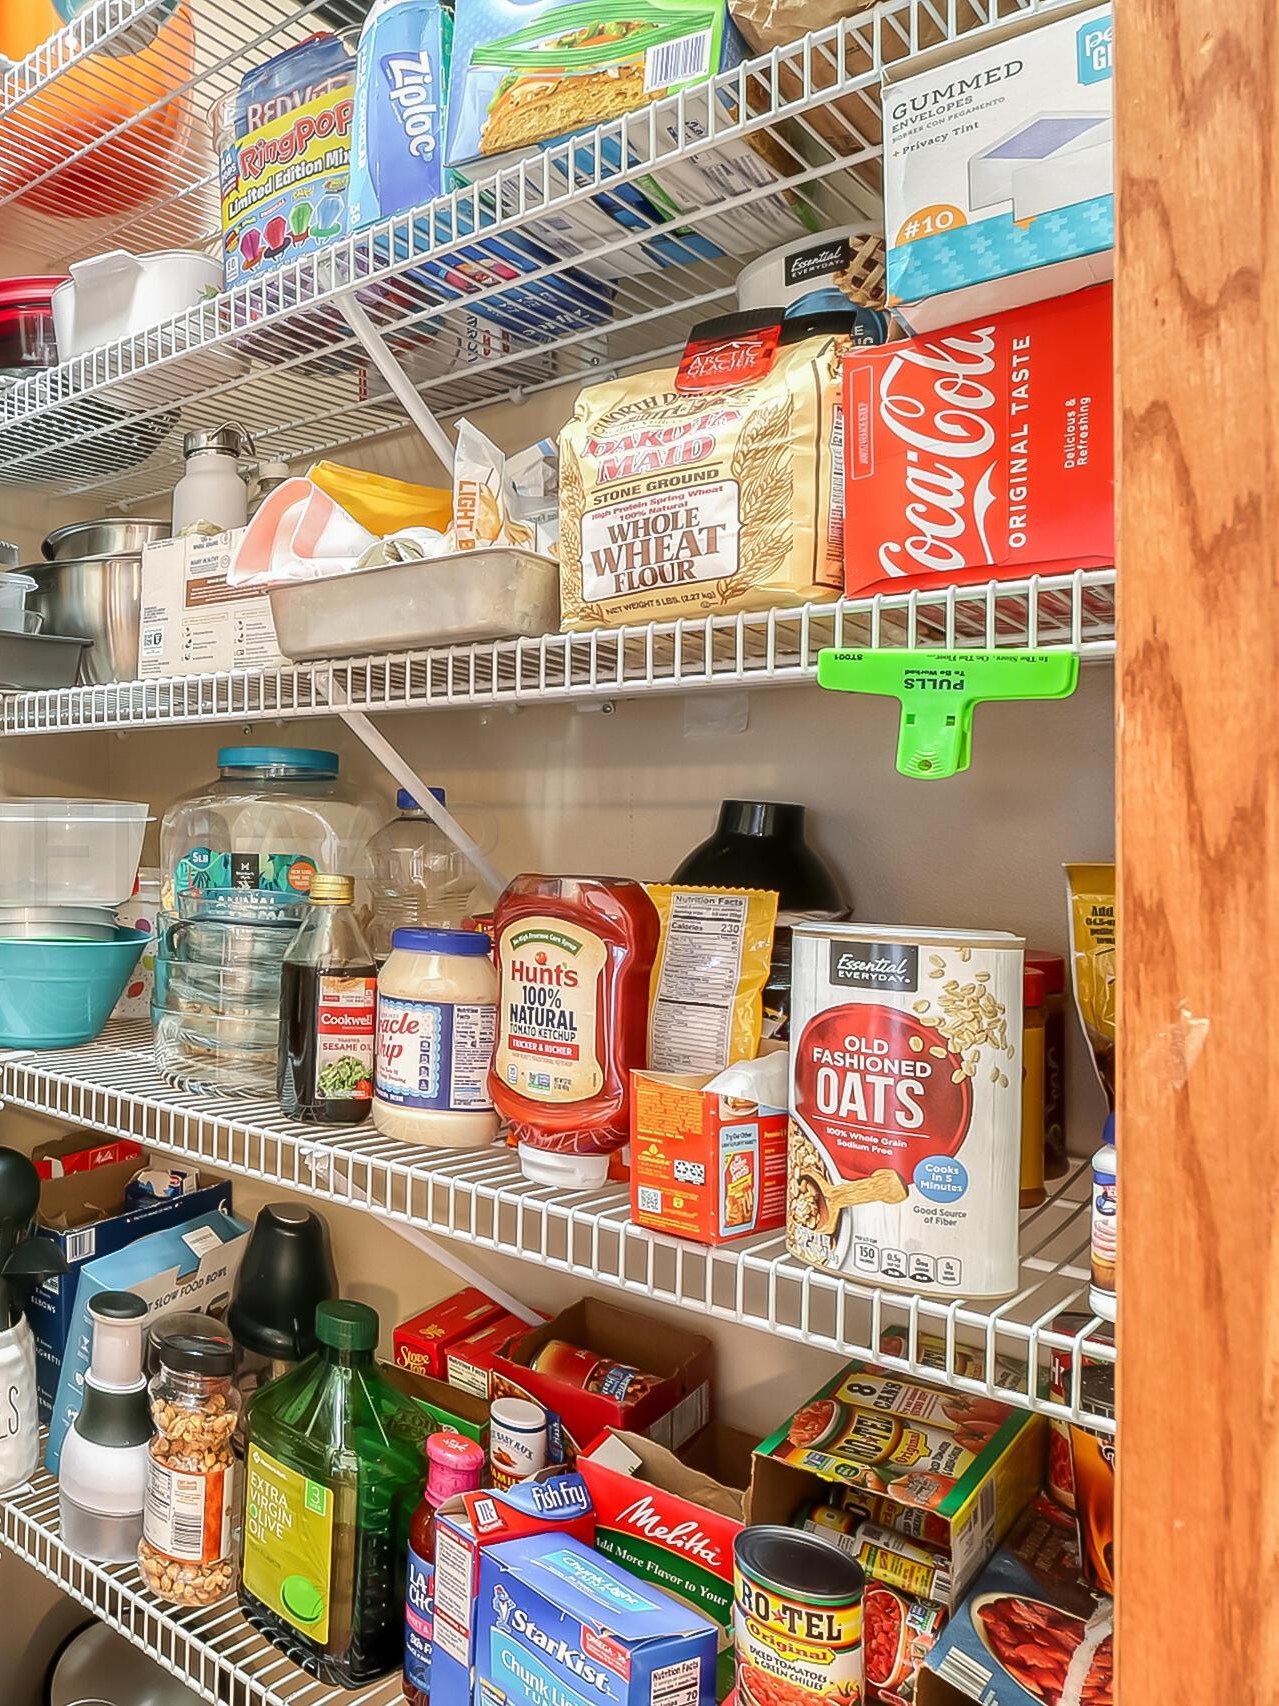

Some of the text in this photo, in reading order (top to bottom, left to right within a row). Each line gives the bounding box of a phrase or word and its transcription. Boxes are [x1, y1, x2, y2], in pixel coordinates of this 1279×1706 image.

[389, 51, 438, 159] Ziploc
[892, 60, 1023, 121] GUMMED
[892, 95, 974, 134] ENVELOPES
[921, 96, 1006, 132] CON PEGAMENTO
[903, 121, 979, 156] Privacy Tint
[228, 147, 350, 221] Limited Edition Mix
[904, 210, 955, 239] #10
[790, 246, 842, 272] Essential
[791, 260, 842, 279] EVERYDAY
[687, 356, 755, 377] GLACIER
[690, 345, 761, 370] ARCTIC
[605, 395, 658, 423] NORTH
[581, 410, 743, 458] DAKOTA
[1009, 335, 1031, 548] ORIGINAL TASTE
[1064, 409, 1076, 469] Delicious
[1077, 397, 1091, 466] Refreshing
[596, 434, 716, 485] MAID
[593, 469, 719, 506] STONE GROUND
[613, 501, 647, 515] Protein
[650, 494, 685, 506] Spring
[688, 485, 724, 498] Wheat
[457, 480, 478, 531] LIGHT
[649, 501, 688, 514] Natural
[607, 507, 700, 544] WHOLE
[591, 523, 726, 577] WHEAT
[613, 559, 697, 594] FLOUR
[624, 600, 654, 612] WEIGHT
[904, 678, 965, 690] PULLS
[675, 895, 743, 907] Nutrition Facts
[671, 922, 740, 934] Calories 230
[511, 960, 579, 988] Hunt's
[837, 953, 908, 975] Essential
[838, 970, 904, 984] EVERYDAY
[522, 985, 562, 1009] 100%
[510, 1003, 578, 1032] NATURAL
[510, 1022, 576, 1042] TOMATO KETCHUP
[323, 1042, 357, 1052] SESAME
[844, 1035, 889, 1056] OLD
[812, 1047, 933, 1079] FASHIONED
[816, 1066, 925, 1129] OATS
[826, 1126, 908, 1148] 100% Whole Grain
[837, 1138, 893, 1155] Sodium Free
[925, 1163, 959, 1175] Cooks
[921, 1181, 963, 1192] Minutes
[913, 1205, 967, 1218] Good Source
[924, 1215, 957, 1226] of Fiber
[859, 1246, 875, 1259] 150
[154, 1286, 178, 1311] SLOW
[180, 1278, 205, 1300] FOOD
[397, 1345, 431, 1367] Stove
[847, 1383, 877, 1396] 8
[894, 1431, 921, 1464] Original
[251, 1472, 289, 1510] EXTRA
[311, 1486, 320, 1504] 3
[532, 1480, 588, 1512] Fish Fry
[249, 1503, 283, 1540] OLIVE
[250, 1487, 293, 1527] VIRGIN
[249, 1519, 267, 1544] OIL
[616, 1494, 721, 1567] Melitta
[615, 1543, 644, 1568] More
[646, 1557, 683, 1584] Flavor
[684, 1579, 697, 1593] to
[699, 1583, 728, 1607] Your
[409, 1585, 434, 1614] CHO
[511, 1609, 611, 1694] StarKist
[750, 1624, 828, 1661] Original
[501, 1650, 549, 1695] Chunk
[652, 1659, 699, 1681] Nutrition Facts
[761, 1660, 823, 1691] GREEN CHILIES
[774, 1658, 827, 1682] TOMATOES
[686, 1690, 697, 1700] 70
